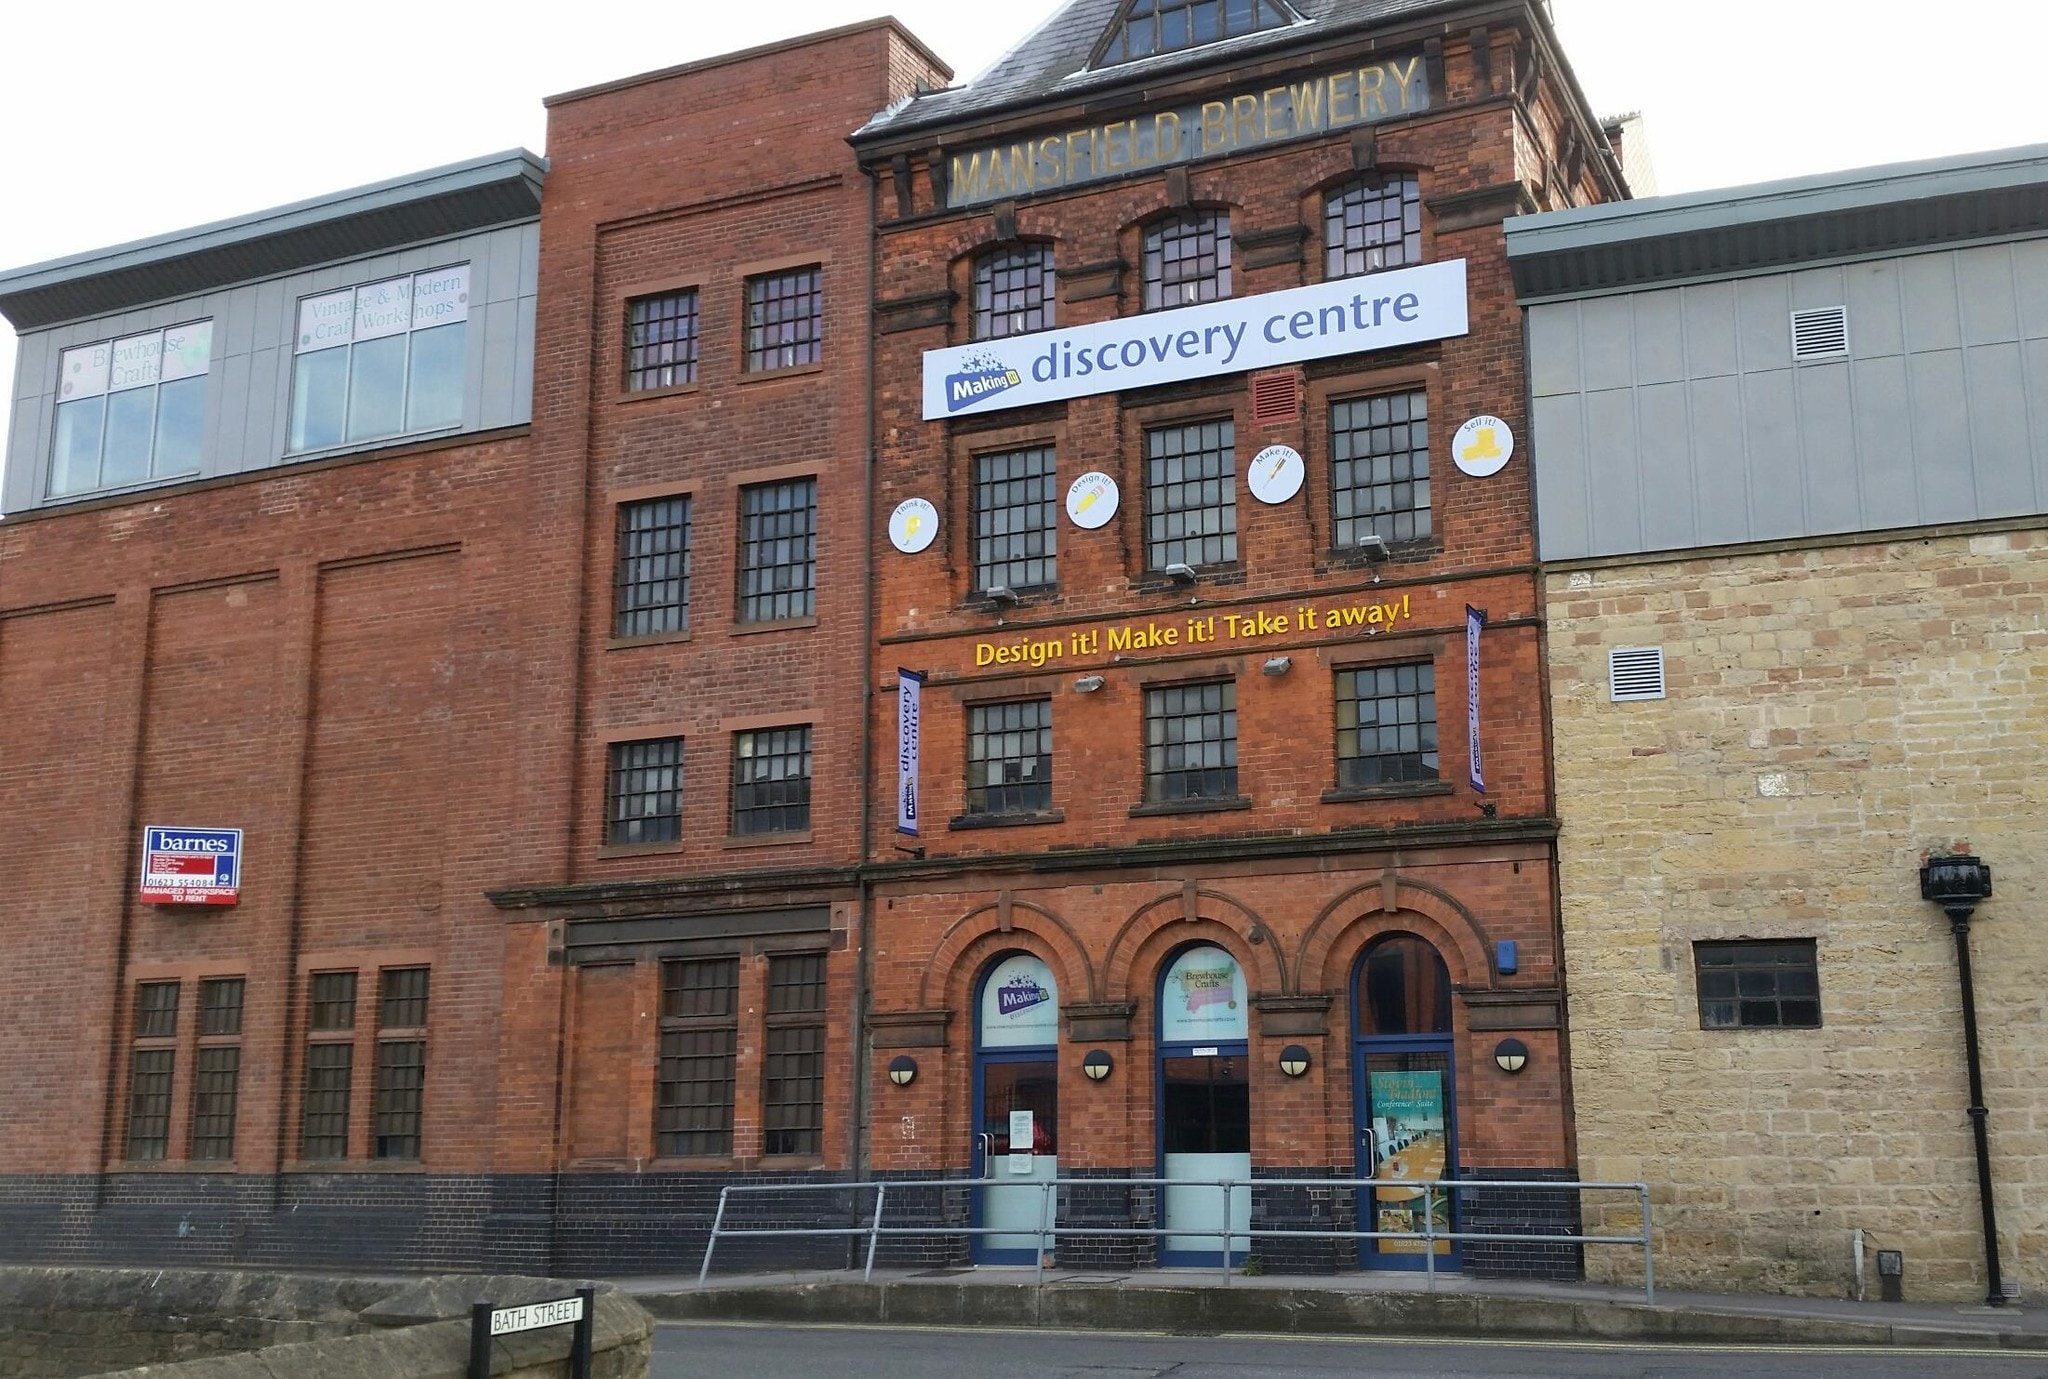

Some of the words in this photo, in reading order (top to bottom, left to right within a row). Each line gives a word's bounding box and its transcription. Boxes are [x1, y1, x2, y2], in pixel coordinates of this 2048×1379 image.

[952, 112, 1181, 200] MANSFIELD
[1201, 56, 1420, 152] BREWERY
[312, 295, 372, 318] Vintage
[377, 288, 391, 305] &
[397, 276, 461, 302] Modern
[361, 299, 455, 329] Workshops
[93, 335, 186, 368] Brewhouse
[953, 375, 1008, 401] Making
[1031, 320, 1248, 383] discovery
[1262, 292, 1420, 345] centre
[111, 360, 160, 386] Crafts
[1464, 417, 1482, 433] Sell
[1484, 416, 1497, 427] it!
[1255, 449, 1280, 465] Make
[1282, 448, 1294, 459] it!
[1071, 474, 1100, 494] Design
[975, 638, 1063, 668] Design
[1070, 629, 1099, 655] it!
[1107, 626, 1179, 653] Make
[1187, 618, 1215, 643] it!
[1223, 610, 1289, 640] Take
[1297, 606, 1318, 632] it
[1326, 594, 1411, 633] away!
[901, 686, 912, 772] discovery
[159, 832, 228, 852] barnes
[143, 887, 185, 895] MANAGED
[186, 888, 236, 896] WORKSPACE
[148, 878, 174, 887] 01623
[178, 879, 214, 887] 554084
[171, 894, 184, 902] TO
[1186, 971, 1229, 981] Brewhouse
[1194, 980, 1220, 989] Crafts
[1003, 991, 1040, 1007] Making
[1377, 1100, 1411, 1110] Conference
[494, 1308, 528, 1332] BATH
[533, 1300, 579, 1325] STREET
